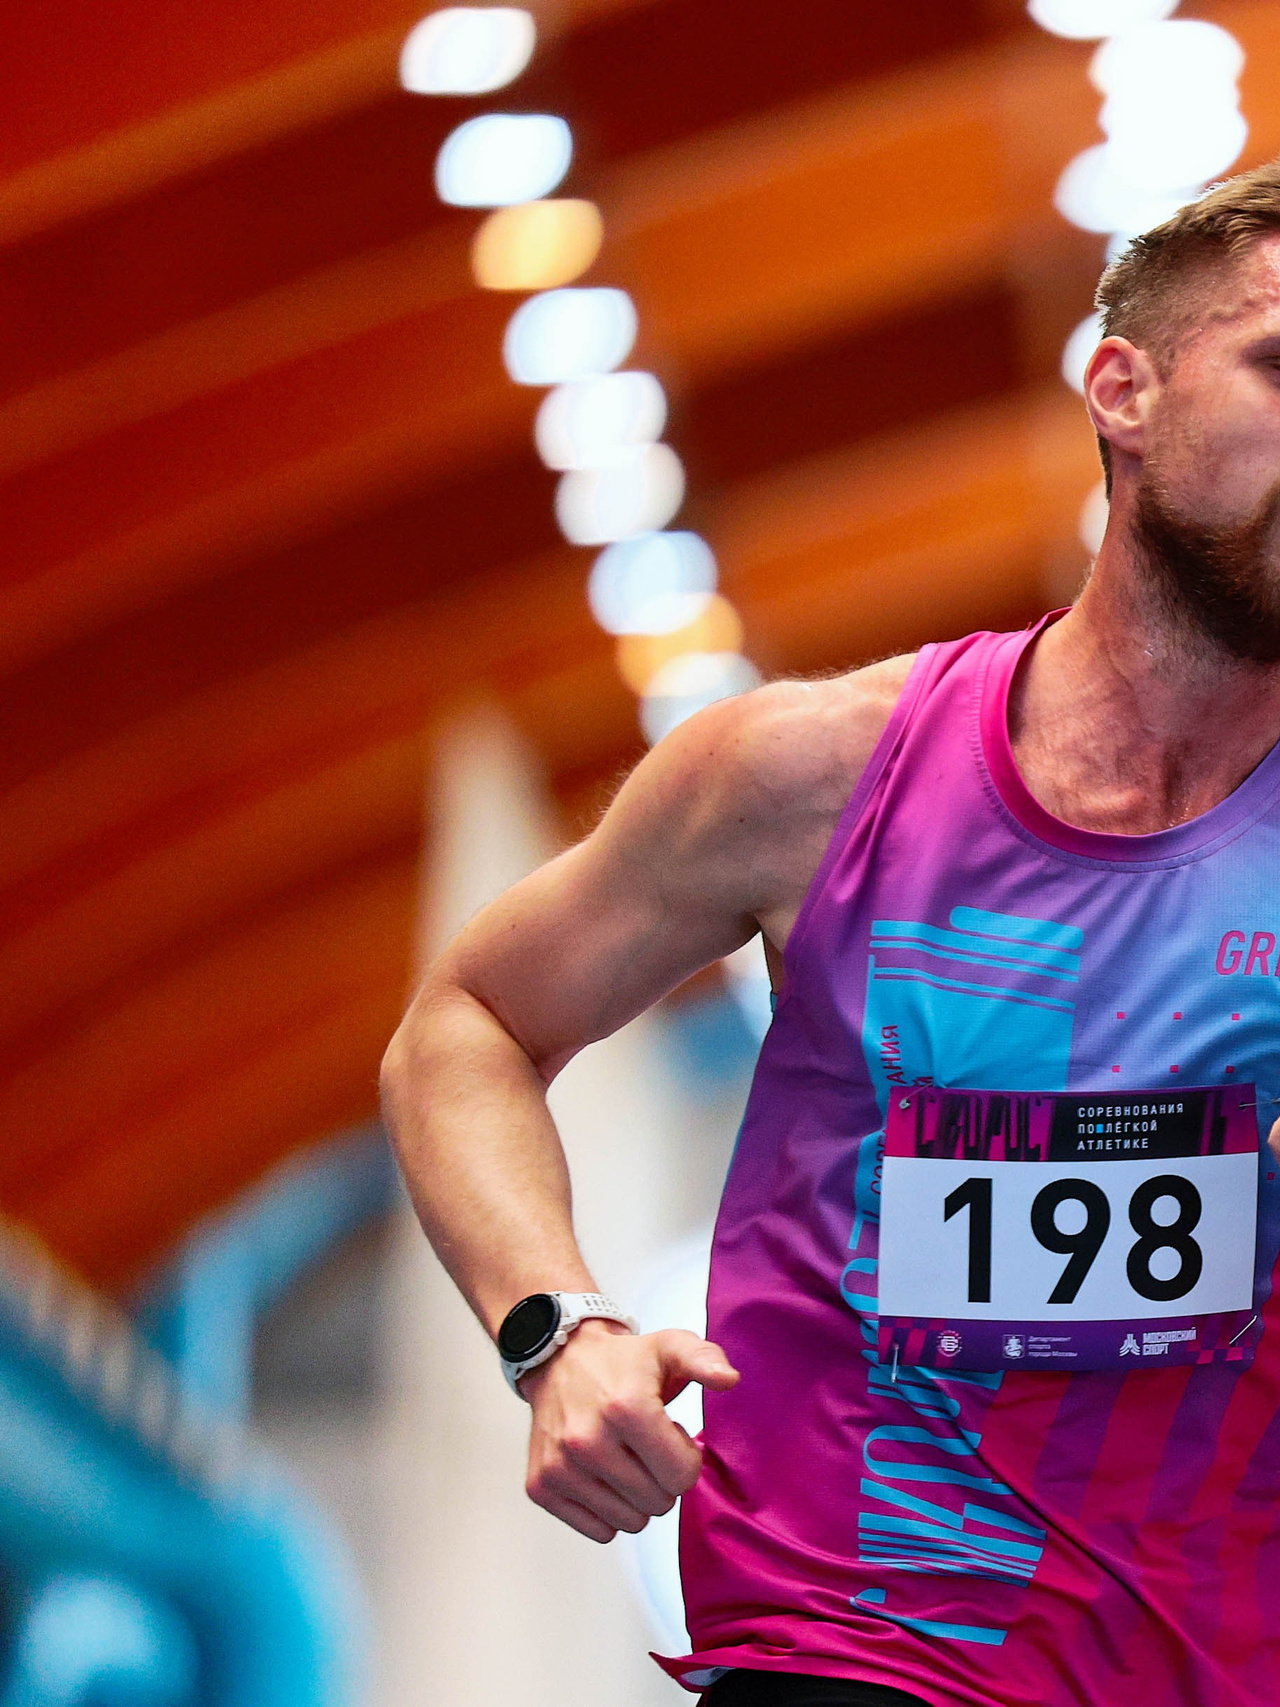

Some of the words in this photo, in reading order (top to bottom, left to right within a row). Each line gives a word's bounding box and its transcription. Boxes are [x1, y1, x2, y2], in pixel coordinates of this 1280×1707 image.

[1077, 1103, 1184, 1118] СОРЕВНОВАНИЯ
[1077, 1123, 1095, 1134] ПО
[1077, 1138, 1149, 1150] АТЛЕТИКЕ
[944, 1174, 1203, 1305] 198
